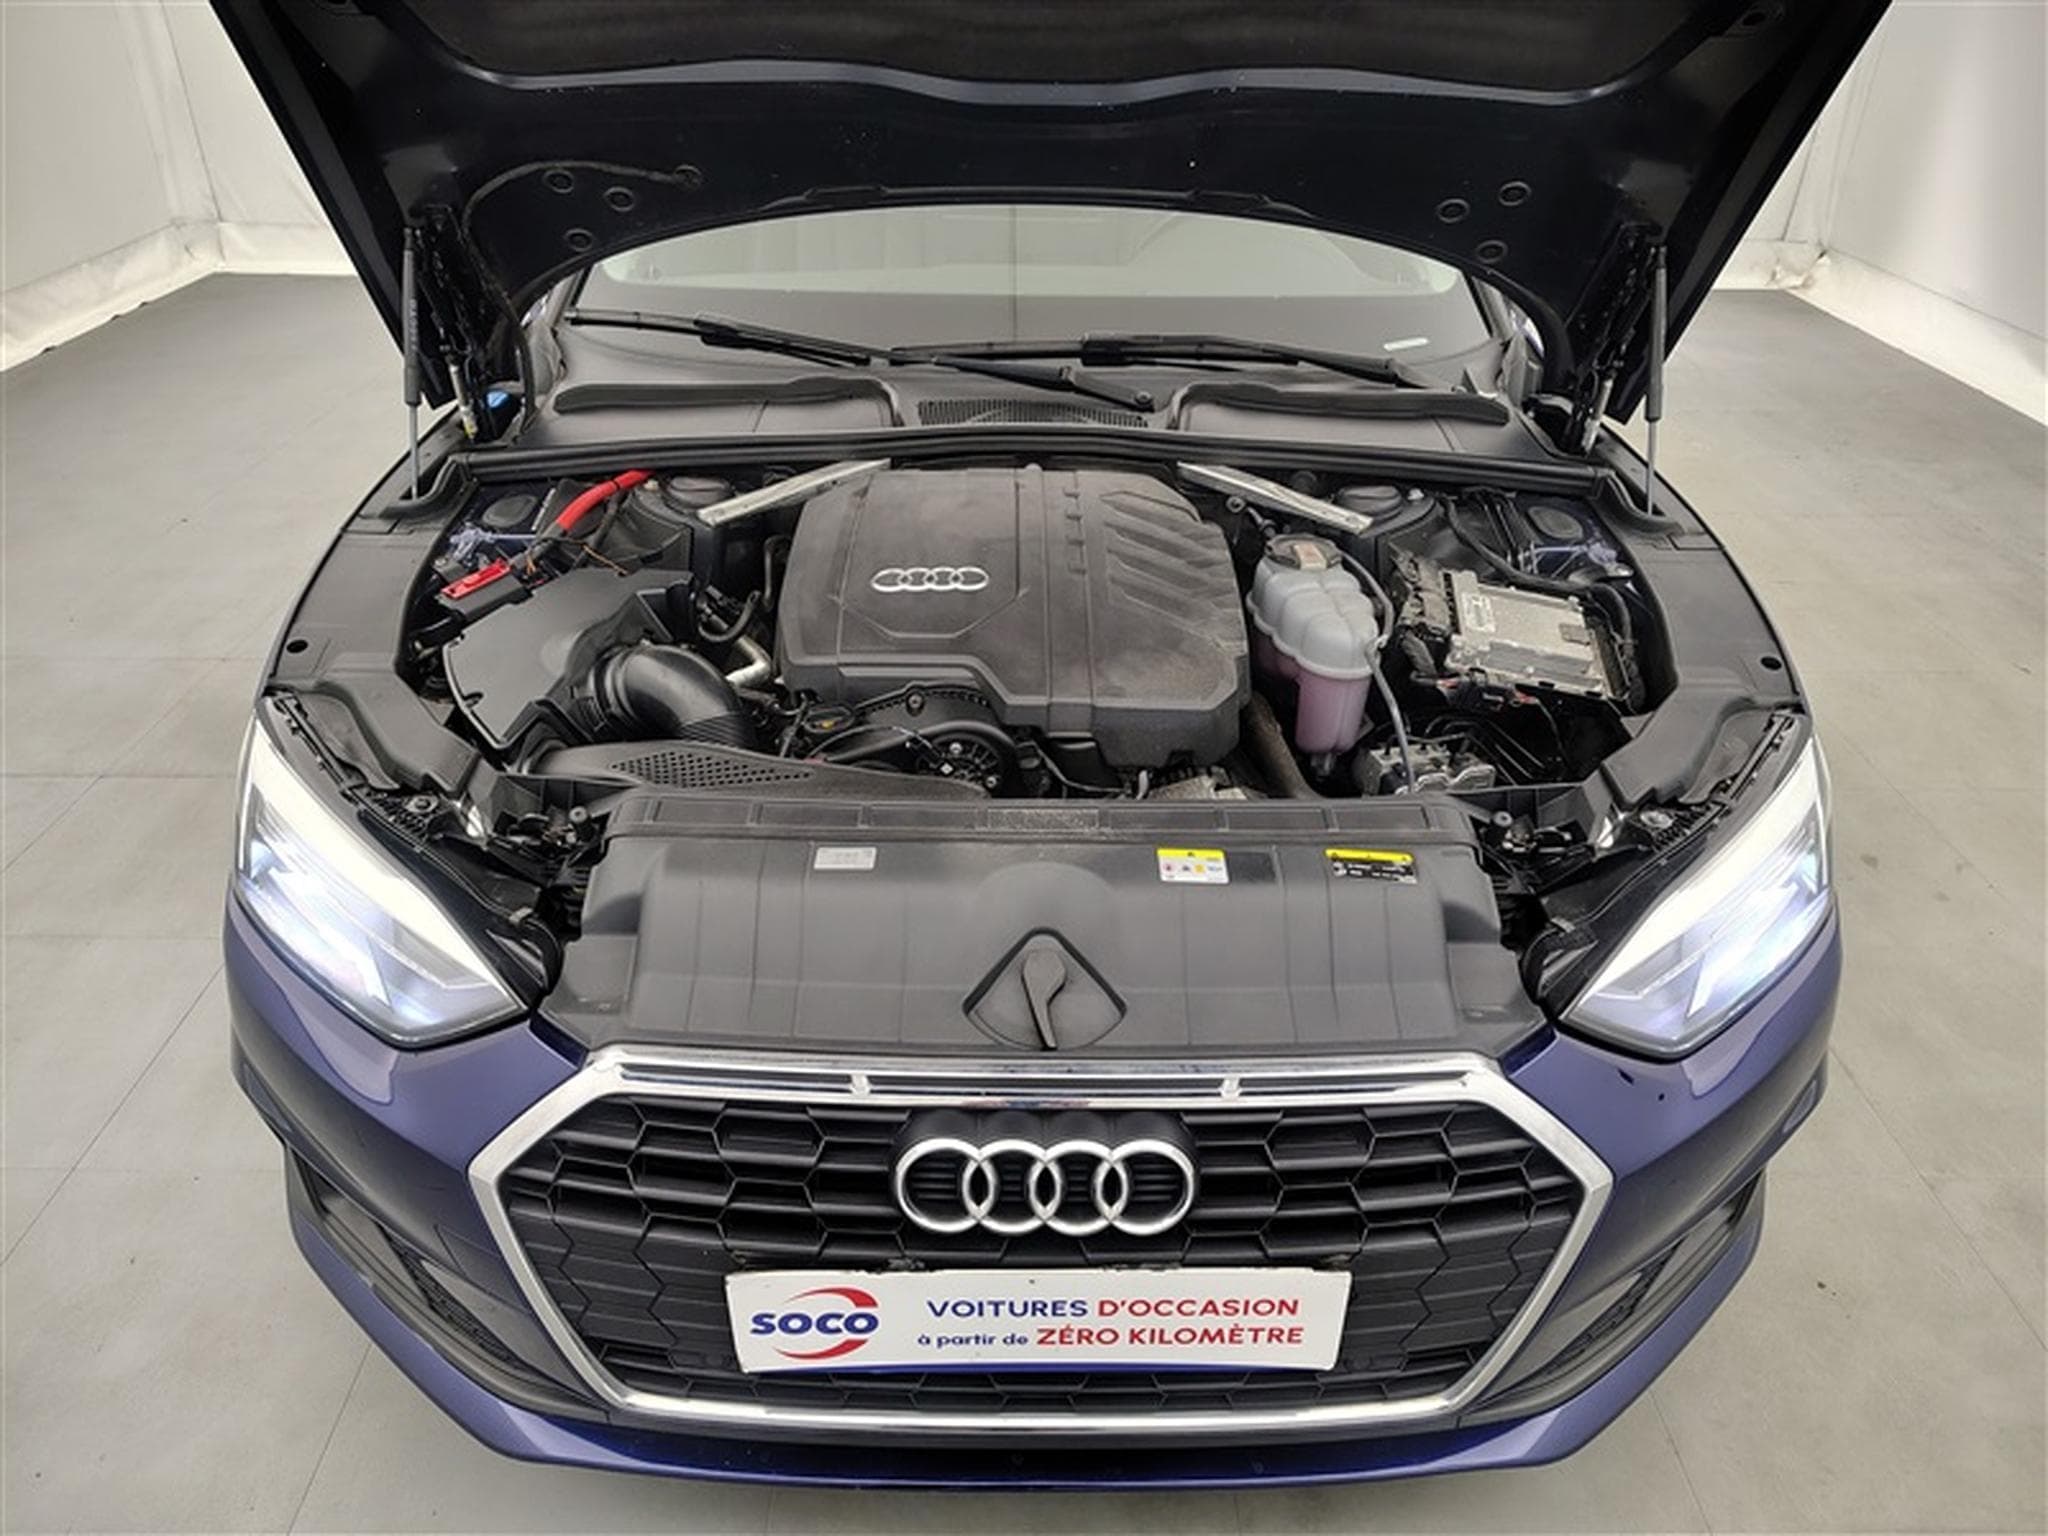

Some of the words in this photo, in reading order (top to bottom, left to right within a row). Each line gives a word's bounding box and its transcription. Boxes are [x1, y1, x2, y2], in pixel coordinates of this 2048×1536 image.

[927, 1300, 1088, 1318] VOITURES
[750, 1312, 879, 1335] SOCO
[917, 1334, 931, 1346] à
[936, 1333, 996, 1349] partir
[1002, 1333, 1029, 1346] de
[1036, 1323, 1120, 1346] ZÉRO
[1128, 1323, 1304, 1346] KILOMÈTRE
